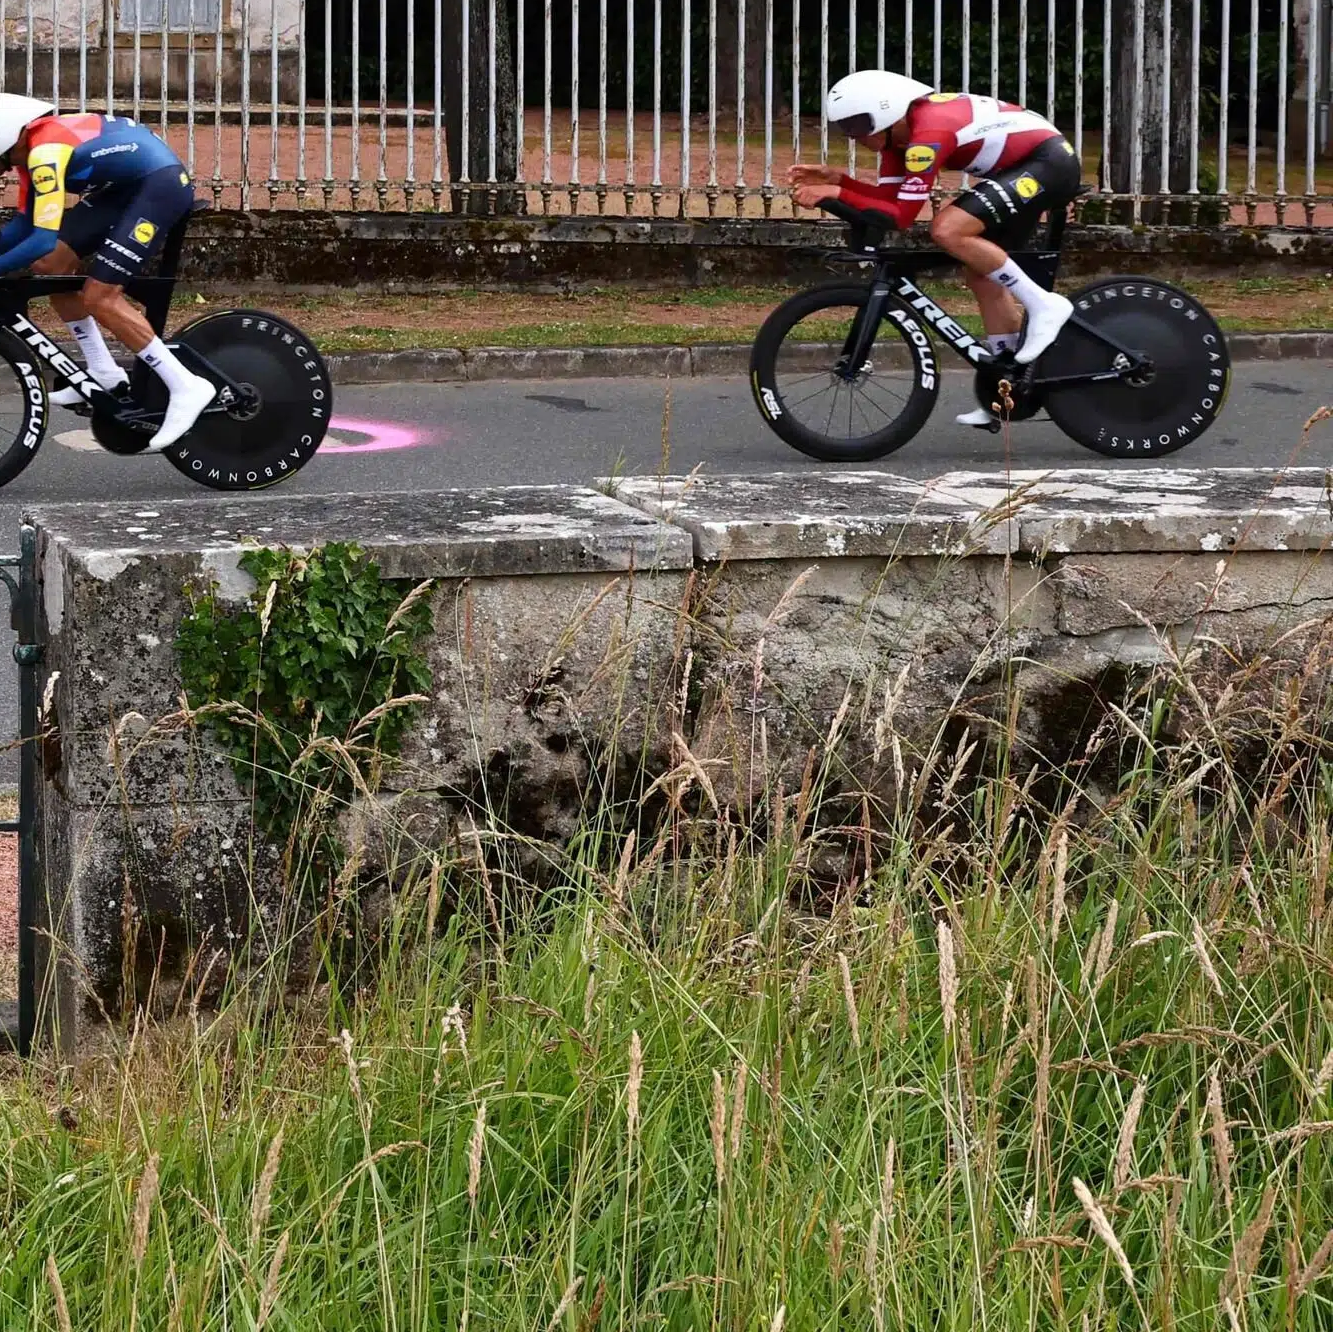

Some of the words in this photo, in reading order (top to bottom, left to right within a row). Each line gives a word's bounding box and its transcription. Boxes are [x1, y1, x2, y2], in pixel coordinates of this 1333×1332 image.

[104, 238, 143, 264] TREK
[897, 276, 992, 363] TREK
[1078, 285, 1200, 321] RINCETON
[11, 313, 104, 406] TREK
[242, 318, 325, 419] PRINCETON
[888, 309, 934, 391] AEOLUS
[1111, 333, 1222, 450] CARBONWORKS
[15, 361, 43, 450] AEOLUS
[761, 387, 783, 421] RSL
[179, 434, 313, 482] CARBONWOR
